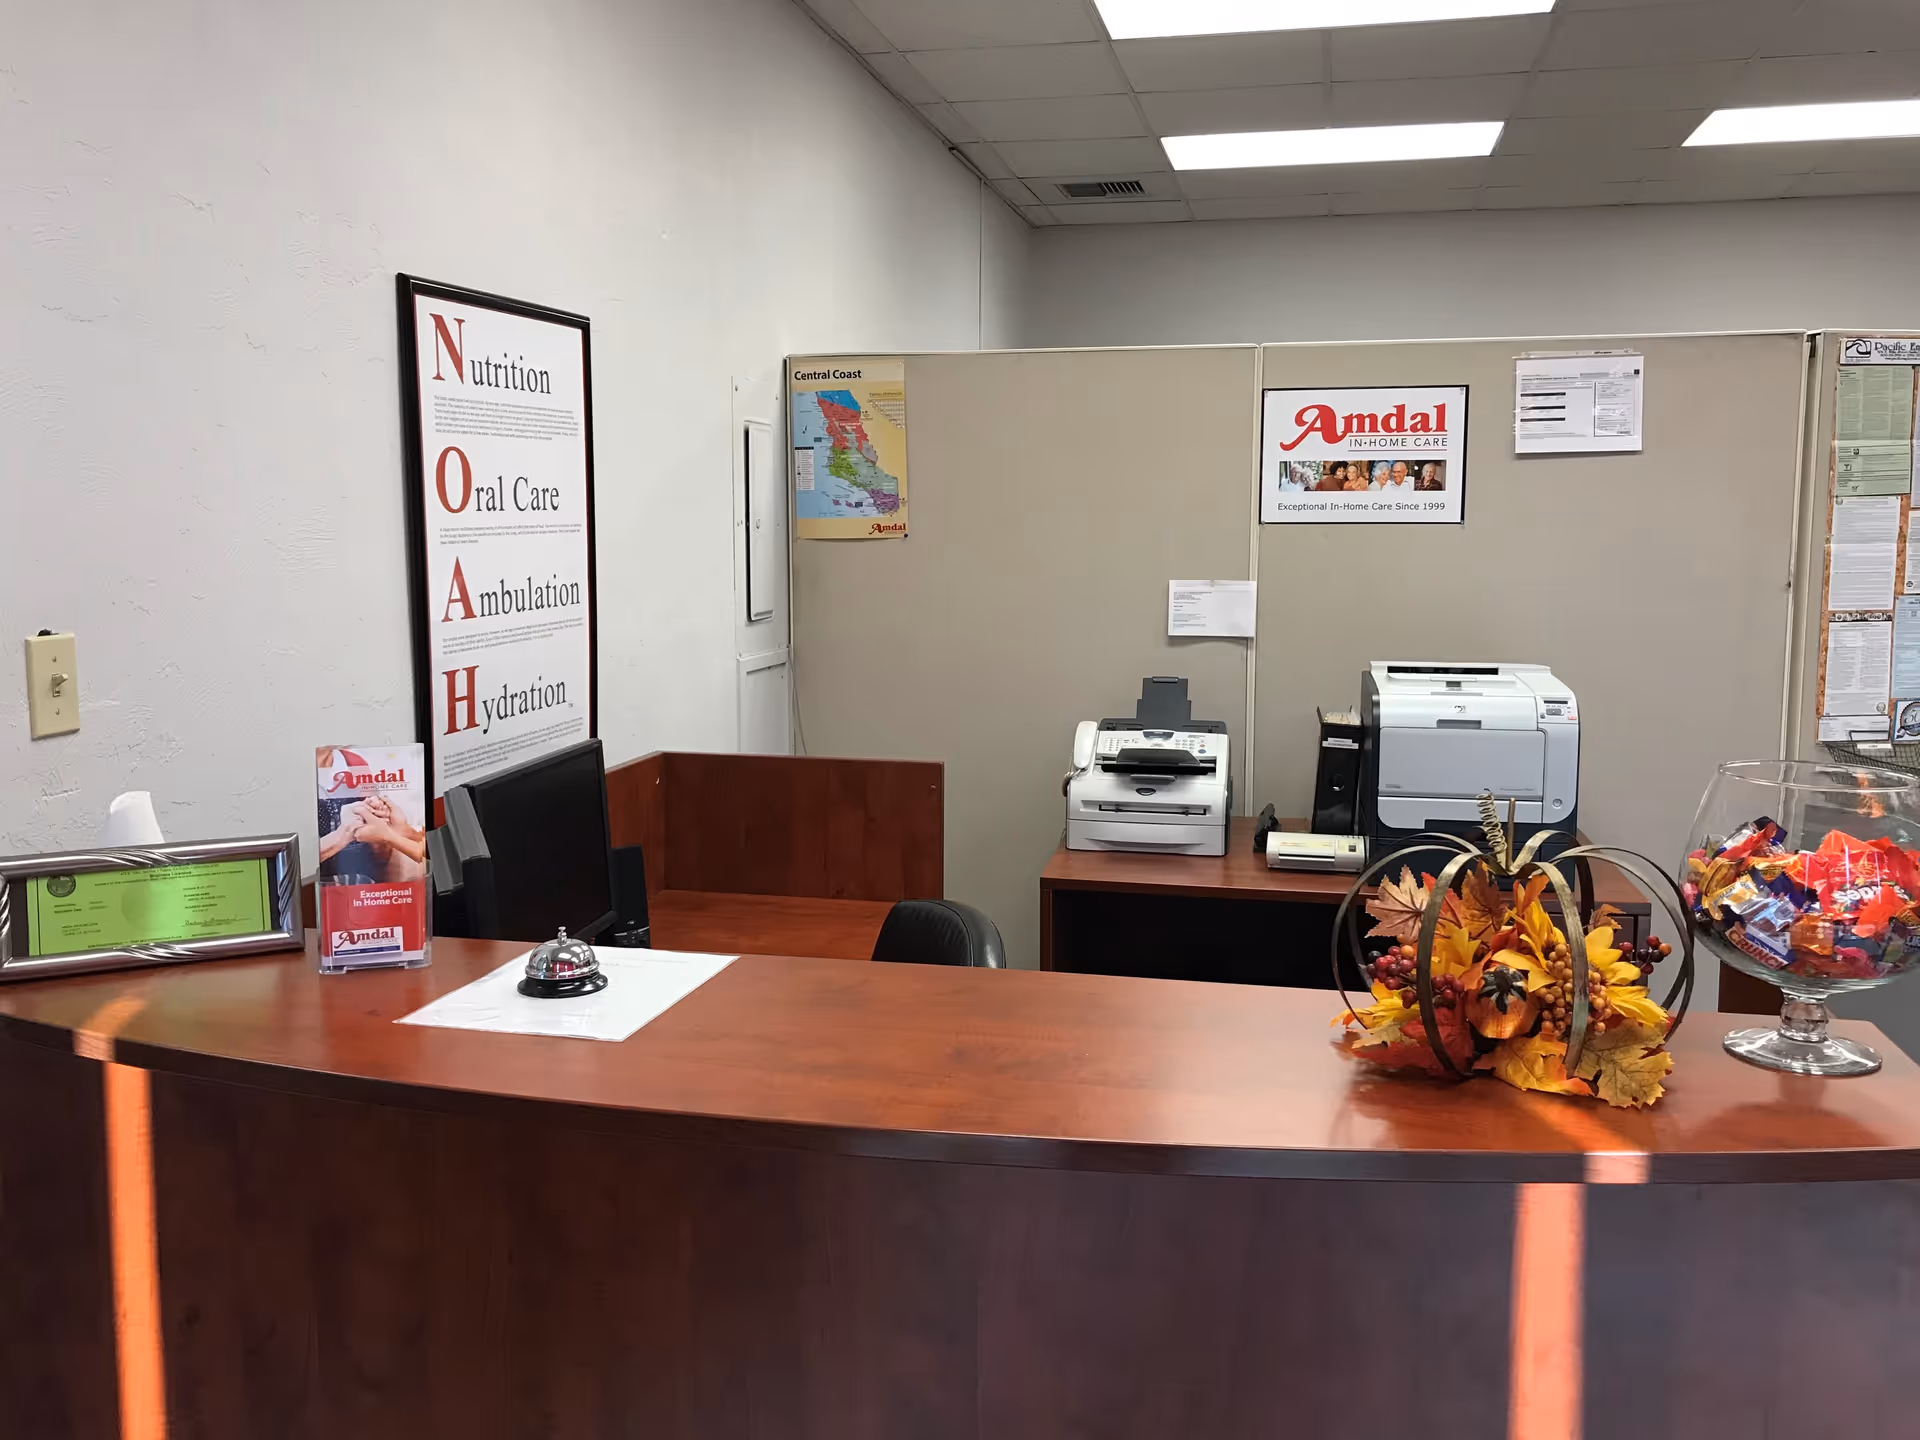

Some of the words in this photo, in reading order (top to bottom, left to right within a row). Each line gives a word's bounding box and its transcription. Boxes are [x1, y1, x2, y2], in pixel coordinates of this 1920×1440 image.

[429, 313, 551, 394] Nutrition
[1875, 342, 1906, 351] Pacific
[794, 370, 830, 381] Central
[833, 369, 862, 379] Coast
[1279, 403, 1448, 451] Amdal
[1414, 437, 1448, 446] CARE
[435, 446, 505, 514] Oral
[513, 476, 560, 512] Care
[1278, 502, 1327, 512] Exceptional
[1330, 503, 1369, 511] In-Home
[1372, 503, 1392, 511] Care
[1395, 502, 1419, 511] Since
[1423, 503, 1445, 511] 1999
[868, 523, 906, 535] Amdal
[441, 556, 580, 622] Ambulation
[442, 665, 566, 735] Hydration
[326, 768, 405, 793] Amdal
[353, 899, 362, 907] In
[364, 898, 390, 906] Home
[392, 896, 412, 905] Care
[360, 888, 412, 899] Exceptional
[334, 927, 395, 949] Amdal
